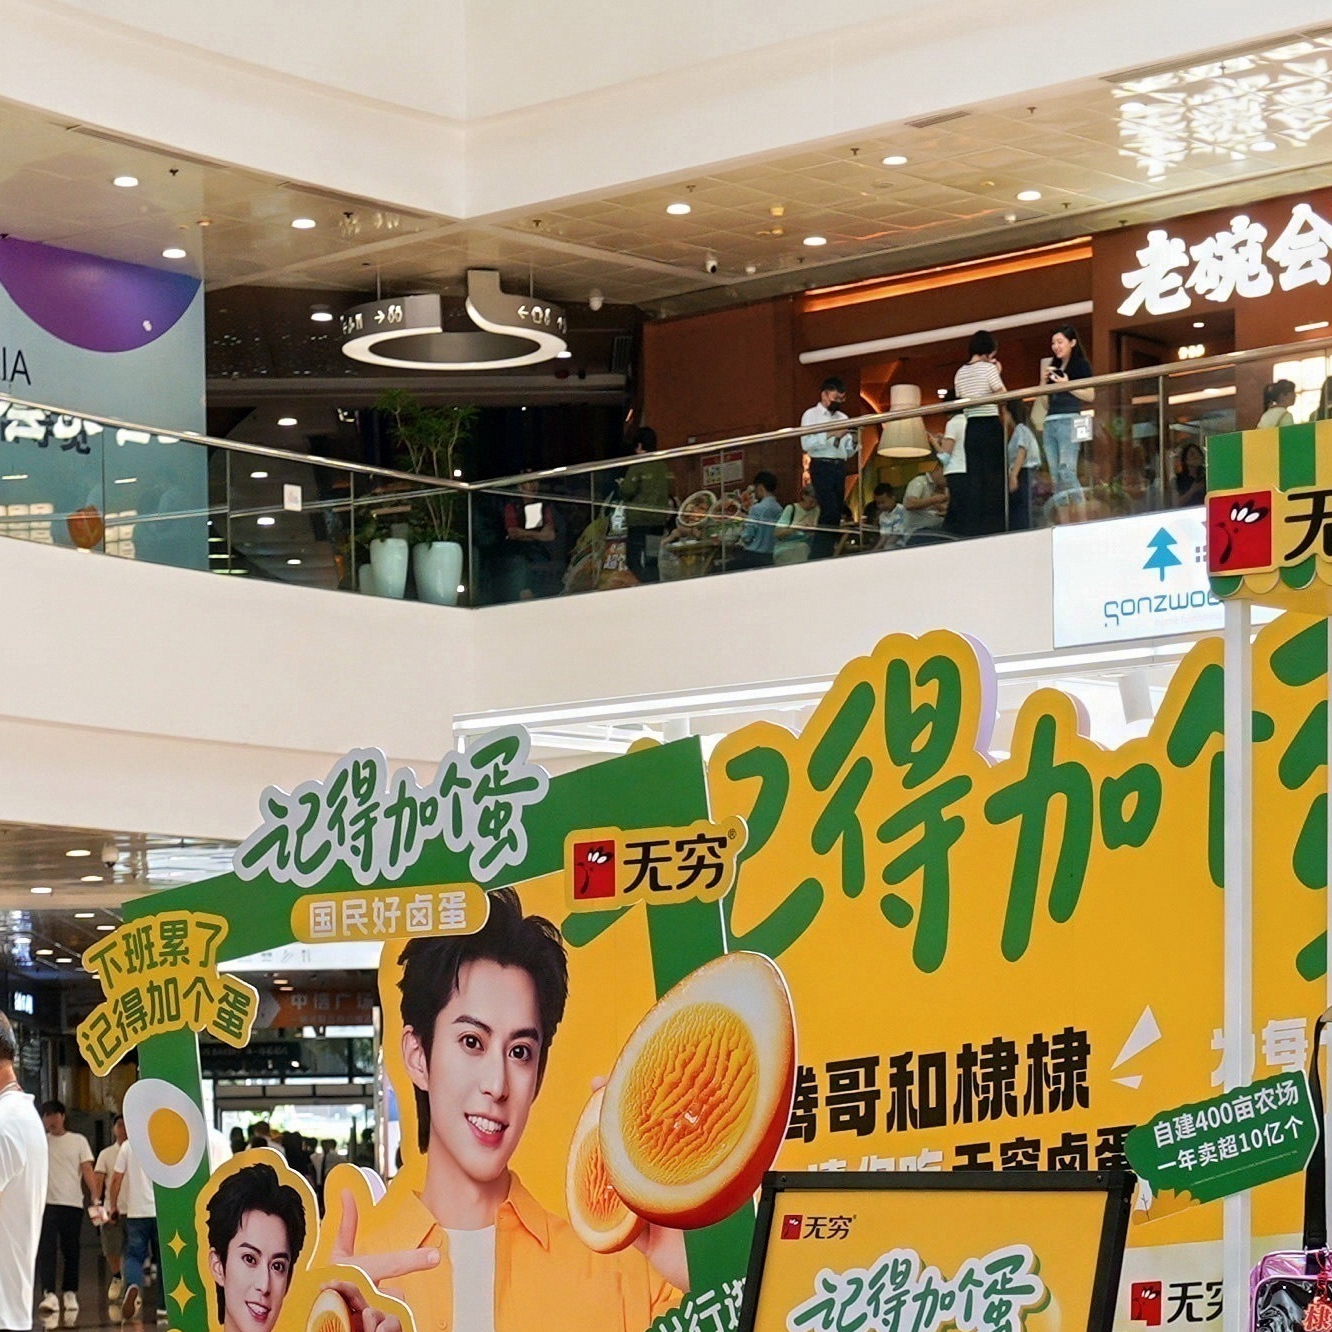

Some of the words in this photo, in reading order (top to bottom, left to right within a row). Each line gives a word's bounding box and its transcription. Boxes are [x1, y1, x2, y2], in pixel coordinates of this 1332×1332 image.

[241, 736, 539, 869] 记得加个蛋
[624, 832, 729, 893] 无穷
[307, 889, 468, 937] 国民好卤蛋
[88, 917, 227, 991] 下班累了
[81, 975, 254, 1070] 记得加个蛋
[1153, 1079, 1300, 1149] 自建400亩农场
[1157, 1115, 1304, 1172] 一年卖超10亿个
[804, 1214, 853, 1241] 无穷
